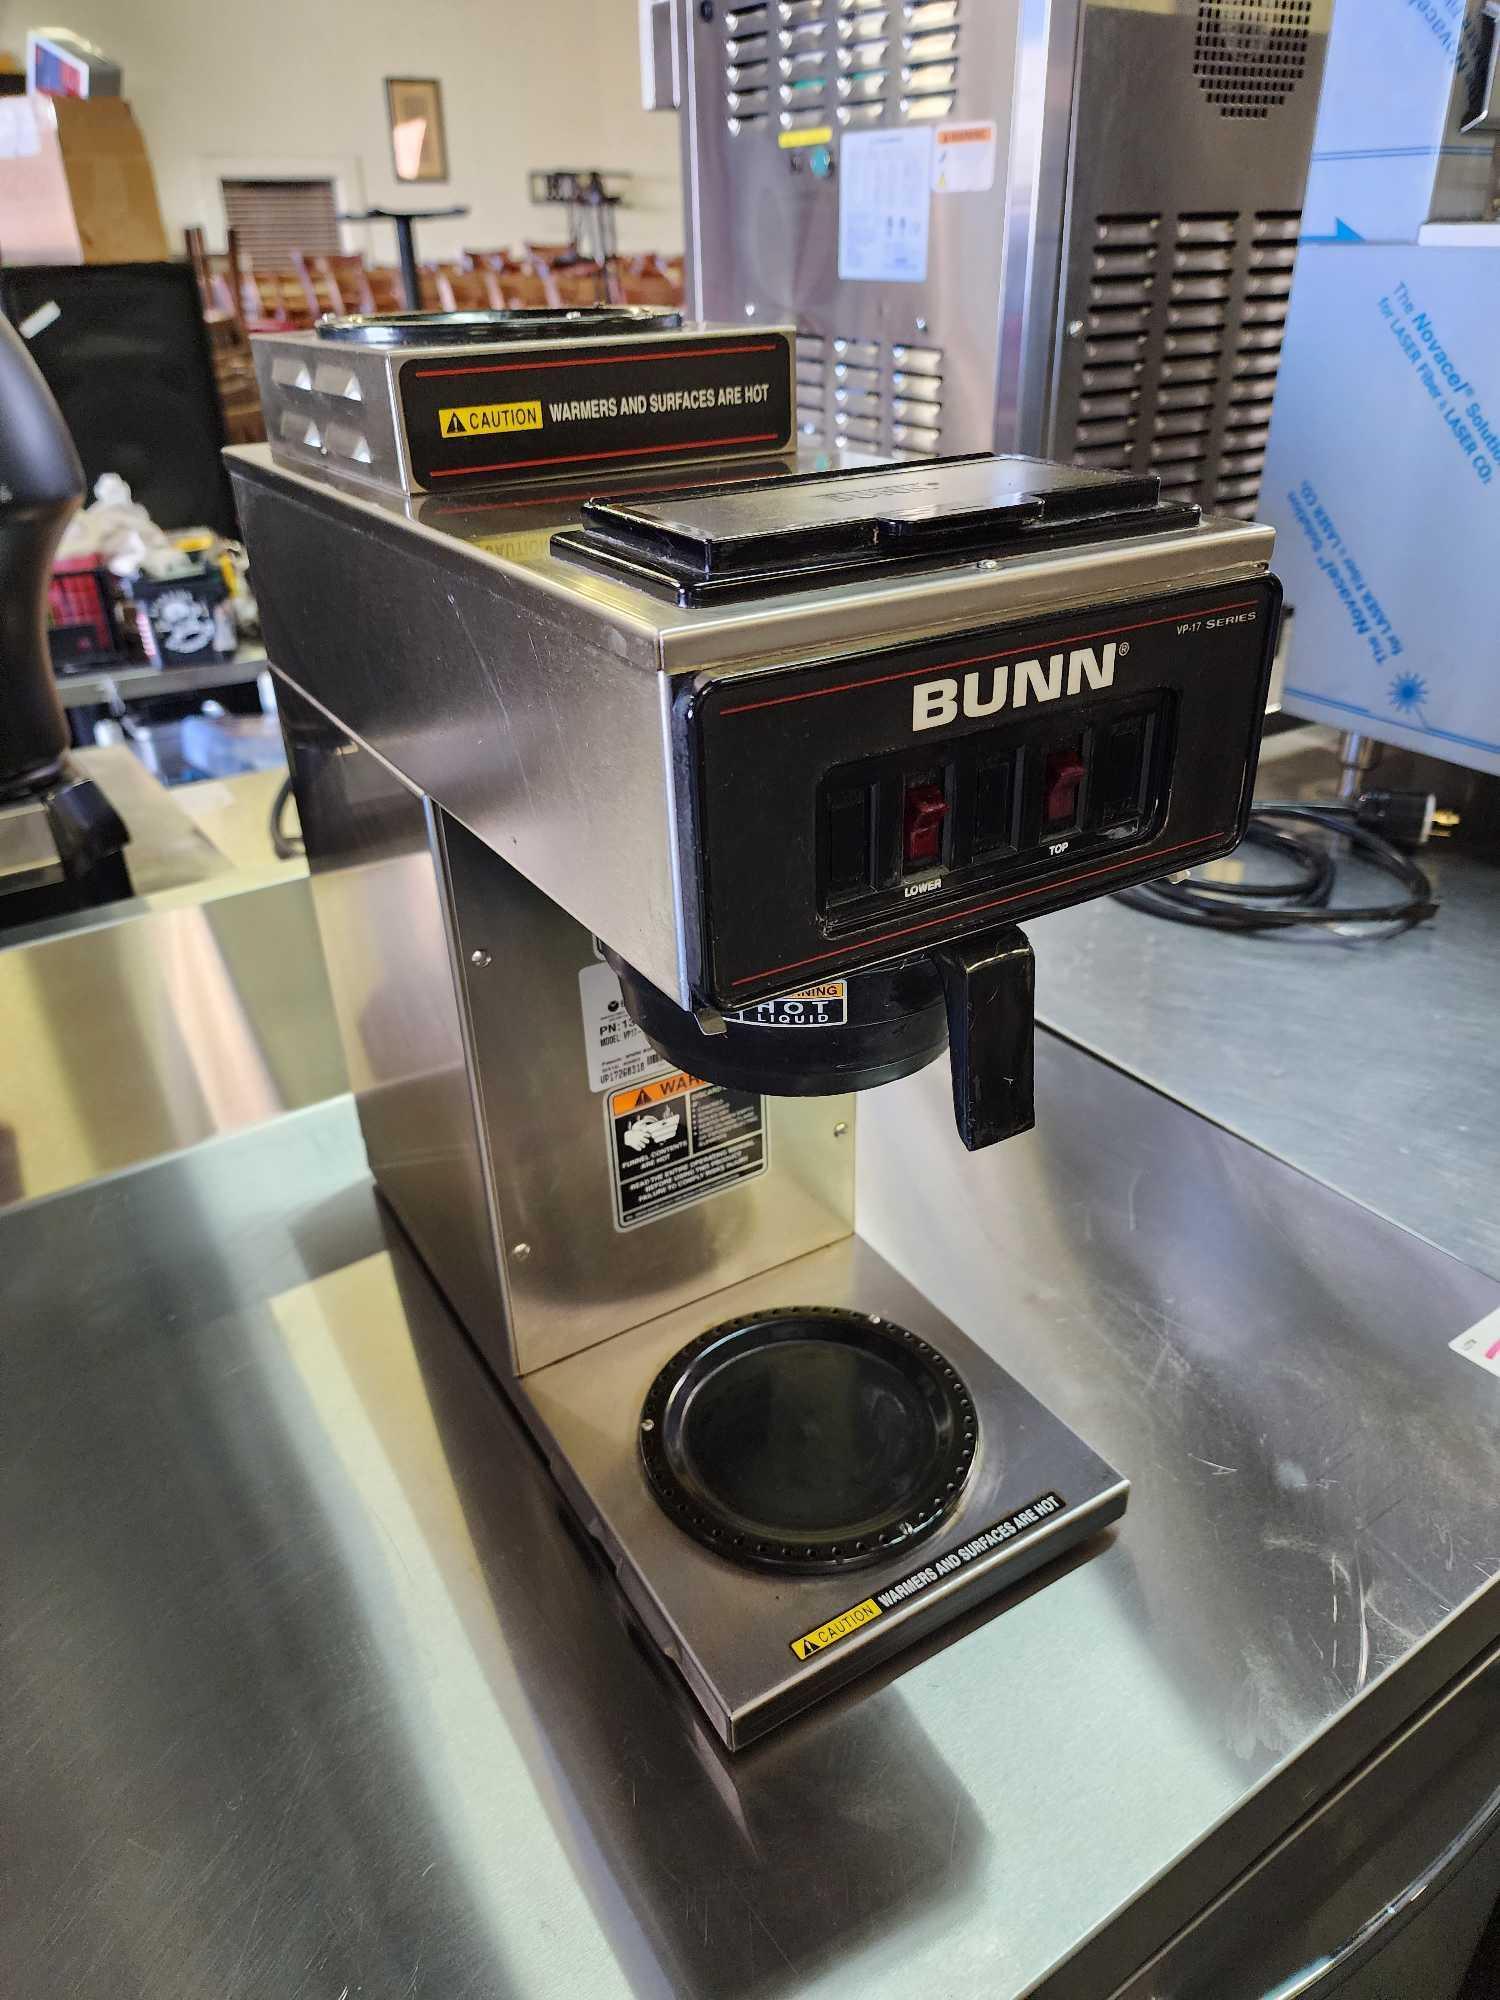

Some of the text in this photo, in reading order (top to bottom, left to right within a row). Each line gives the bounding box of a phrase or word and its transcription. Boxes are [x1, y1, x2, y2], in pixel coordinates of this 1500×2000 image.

[1394, 281, 1414, 315] The
[1378, 297, 1393, 318] for
[1390, 318, 1422, 364] LASER
[1444, 408, 1478, 456] LASER
[469, 383, 770, 430] CAUTION WARMERS AND SURFACES ARE HOT
[1176, 611, 1257, 636] VP-17 SERIES
[1048, 841, 1069, 856] TOP
[904, 878, 942, 898] LOWER
[757, 1001, 829, 1015] HOT
[757, 1013, 829, 1024] LIQUID
[818, 1494, 1061, 1643] CAUTION WARMERS AND SURFACES ARE HOT
